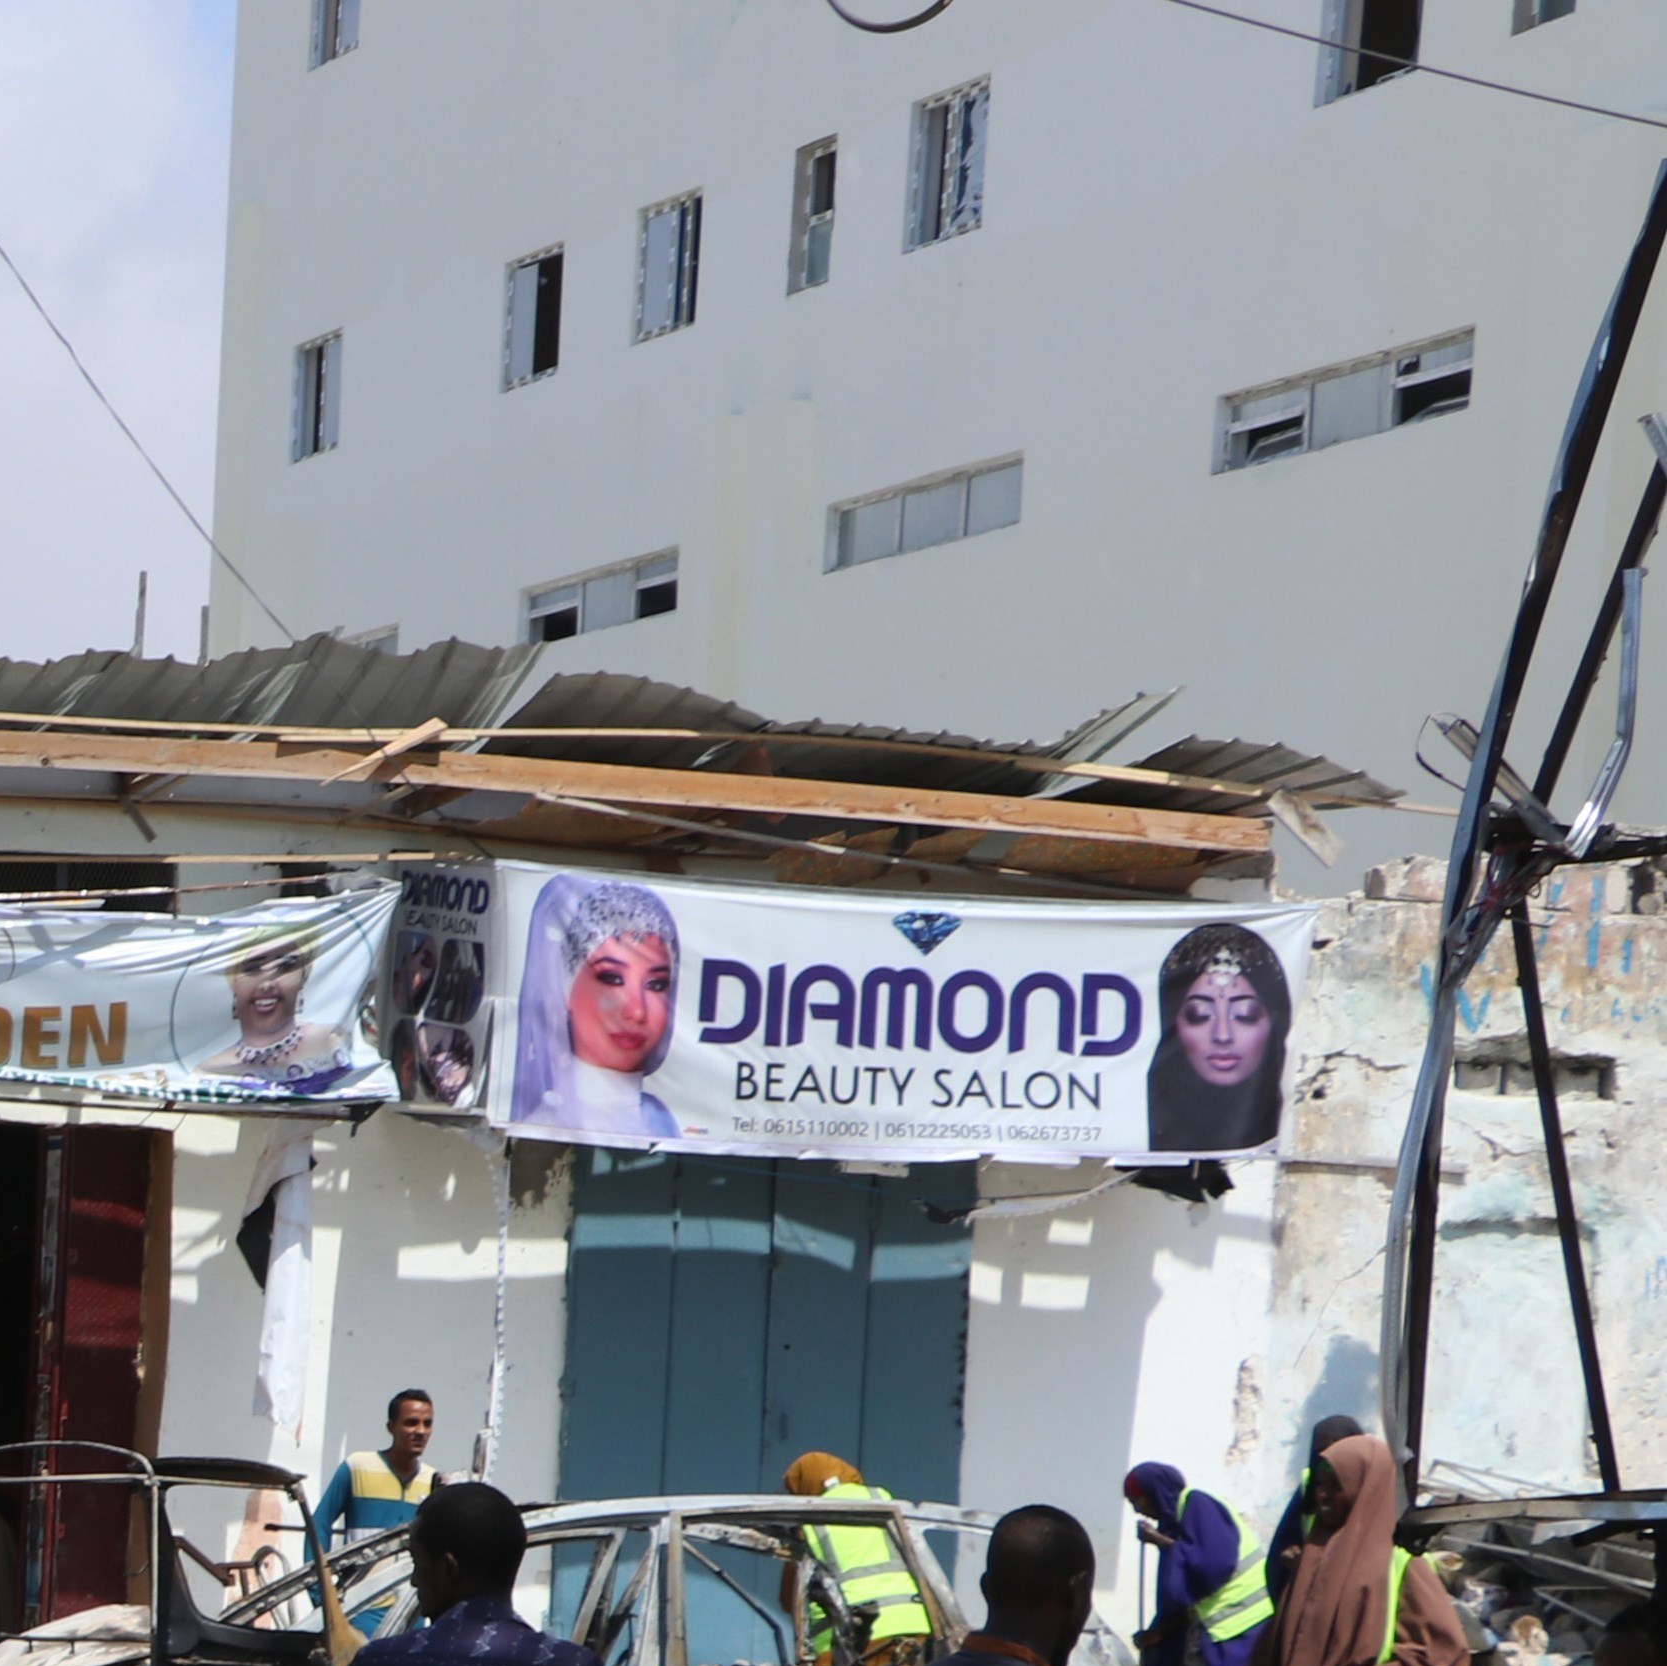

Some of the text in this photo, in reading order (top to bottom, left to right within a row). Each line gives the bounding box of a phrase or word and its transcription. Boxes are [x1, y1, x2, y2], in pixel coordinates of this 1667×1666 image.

[697, 957, 1144, 1058] DIAMOND
[734, 1061, 1103, 1111] BEAUTY SALON
[732, 1116, 759, 1134] Tel:
[763, 1116, 869, 1138] 0615110002
[884, 1122, 993, 1140] 0612225053
[1007, 1125, 1103, 1142] 062673737
